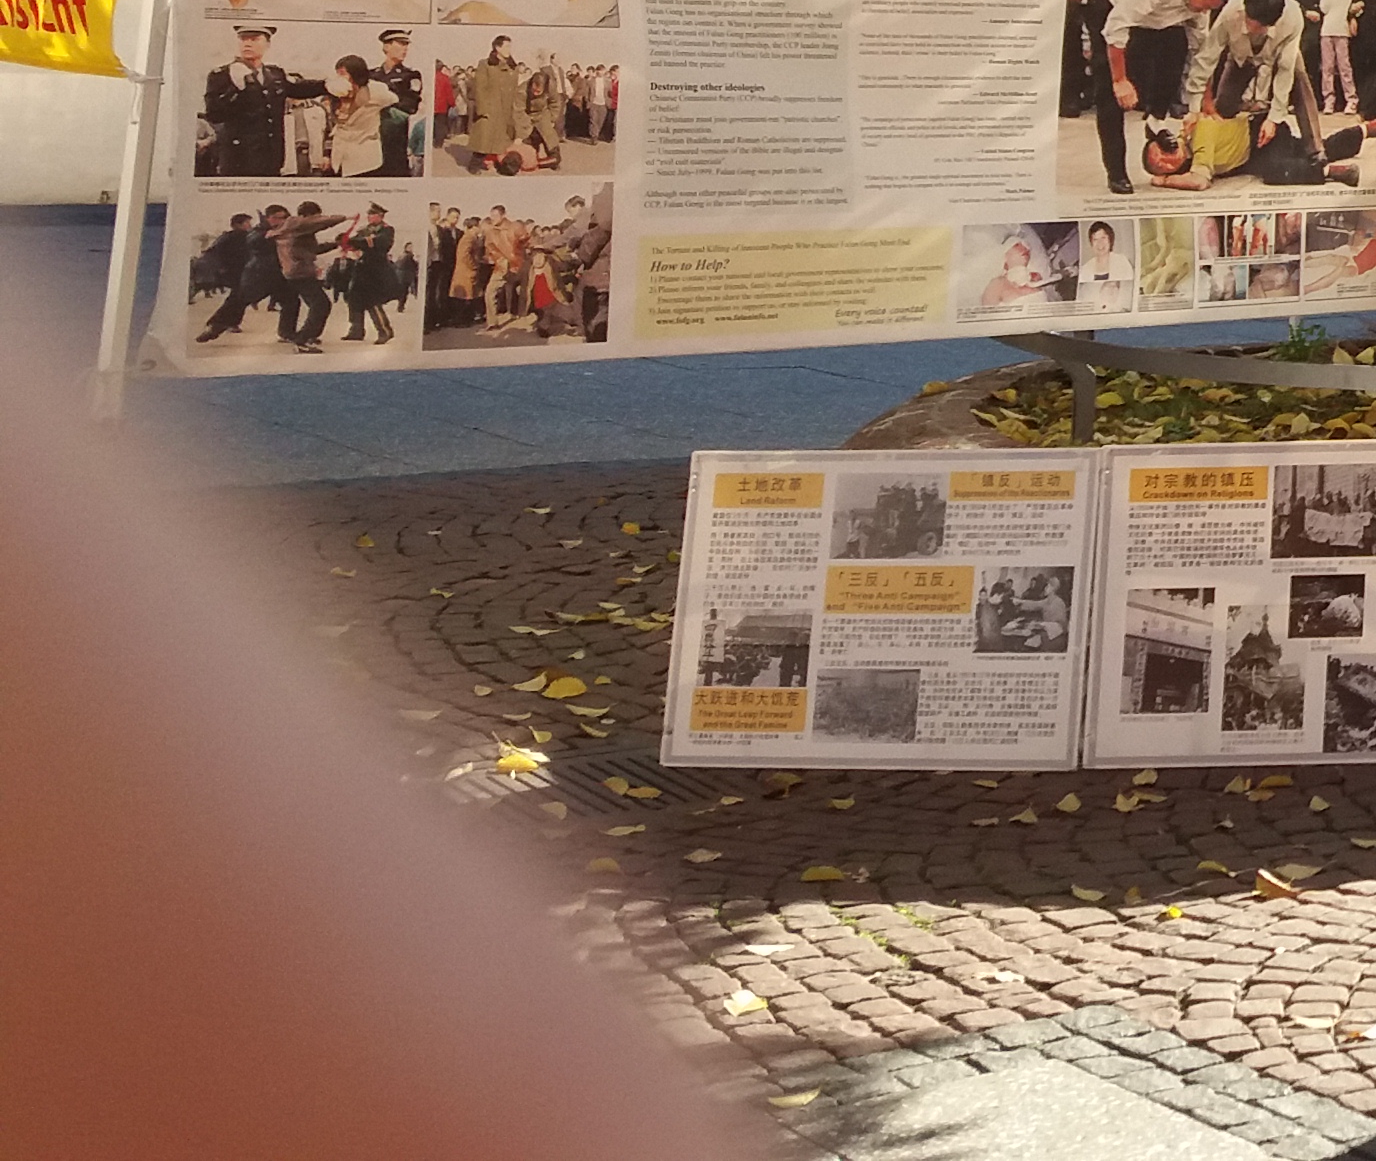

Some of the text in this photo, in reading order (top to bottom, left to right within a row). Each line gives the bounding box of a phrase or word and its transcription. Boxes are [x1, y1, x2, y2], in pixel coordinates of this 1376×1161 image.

[650, 82, 698, 92] Destroying
[700, 83, 722, 91] other
[650, 258, 730, 272] How to Help?
